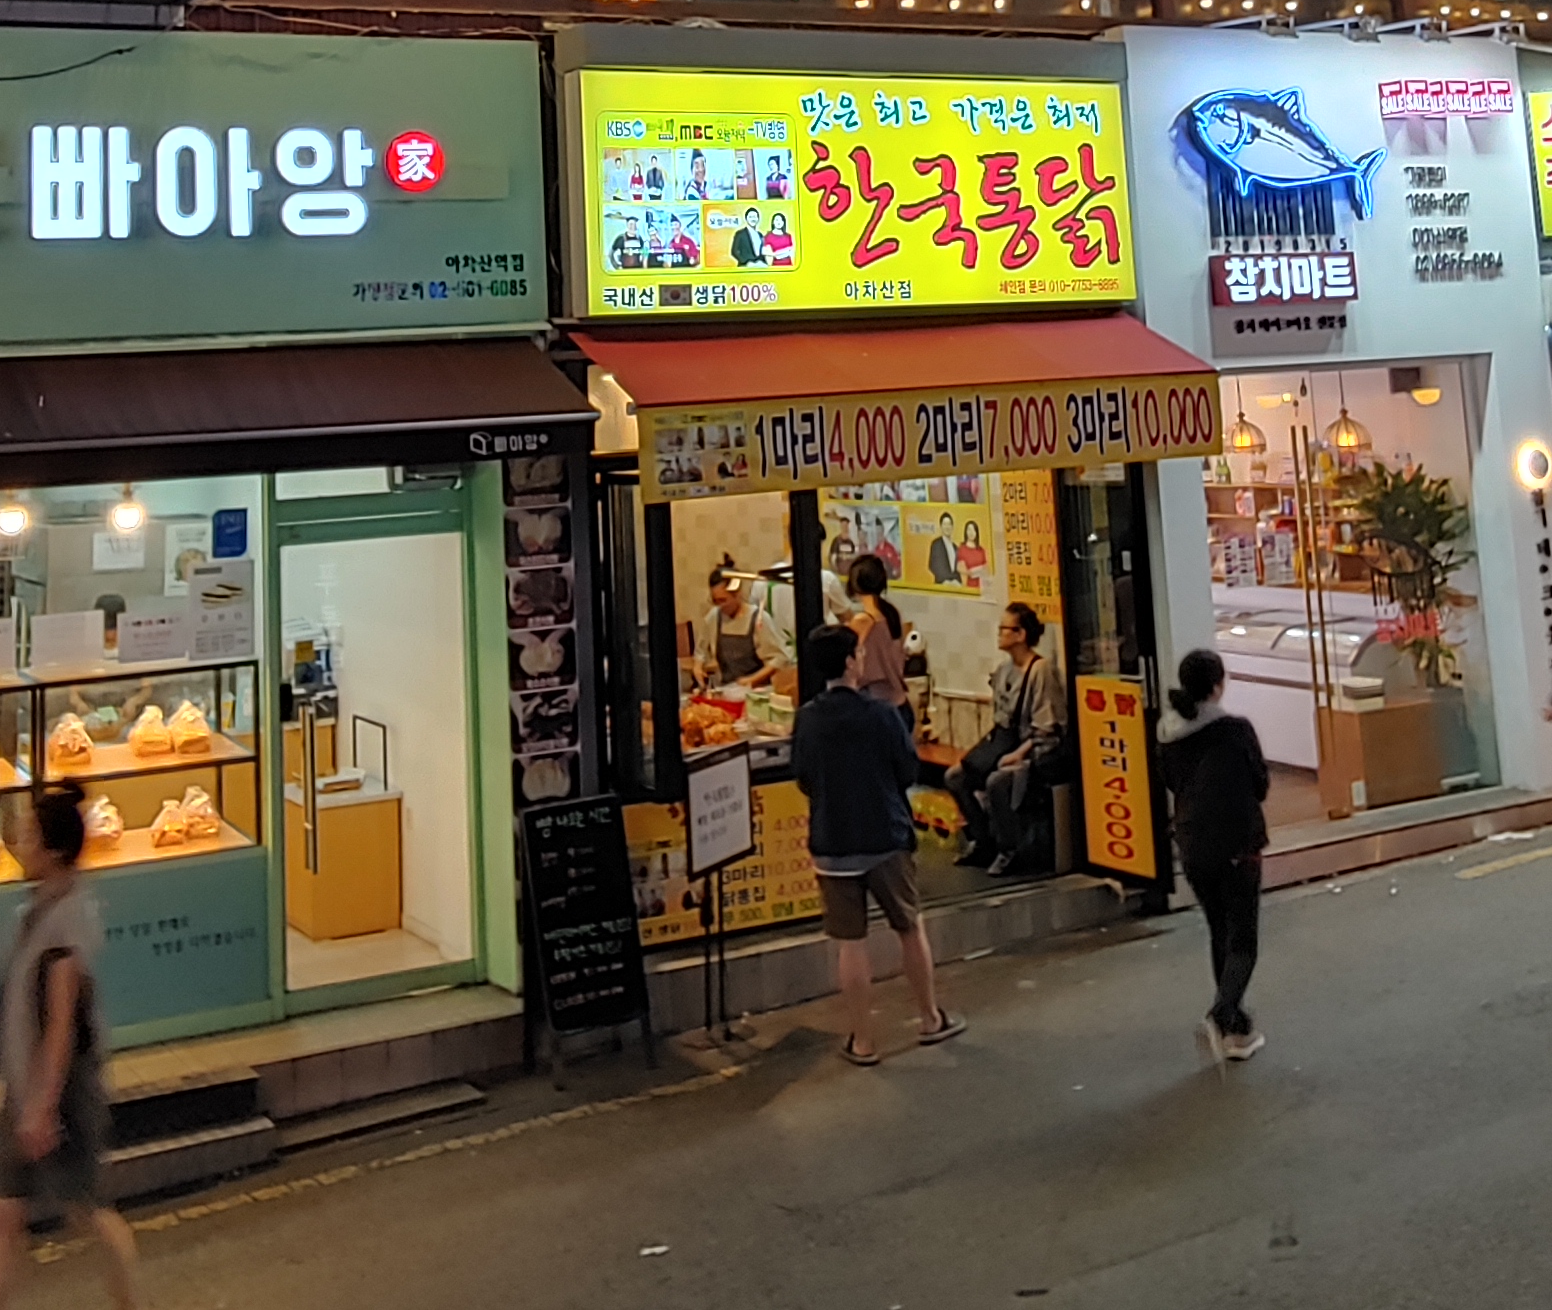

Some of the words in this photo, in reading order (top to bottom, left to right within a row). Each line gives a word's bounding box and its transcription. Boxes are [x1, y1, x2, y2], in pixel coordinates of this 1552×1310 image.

[800, 90, 858, 135] 맛은
[873, 92, 931, 124] 최고
[949, 96, 1033, 135] 가격은
[1046, 96, 1101, 135] 최저
[1381, 96, 1406, 114] SALE
[1407, 93, 1431, 111] SALE
[1448, 93, 1472, 111] SALE
[1489, 93, 1513, 111] SALE
[607, 121, 632, 137] KBS
[392, 138, 440, 186] 家
[27, 123, 378, 241] 빠아앙
[801, 140, 1122, 272] 한국통닭
[445, 253, 525, 274] 아차산역점
[1029, 280, 1047, 293] 문의
[1224, 255, 1355, 302] 참치마트
[603, 287, 654, 308] 국내산
[844, 280, 913, 300] 아차산점
